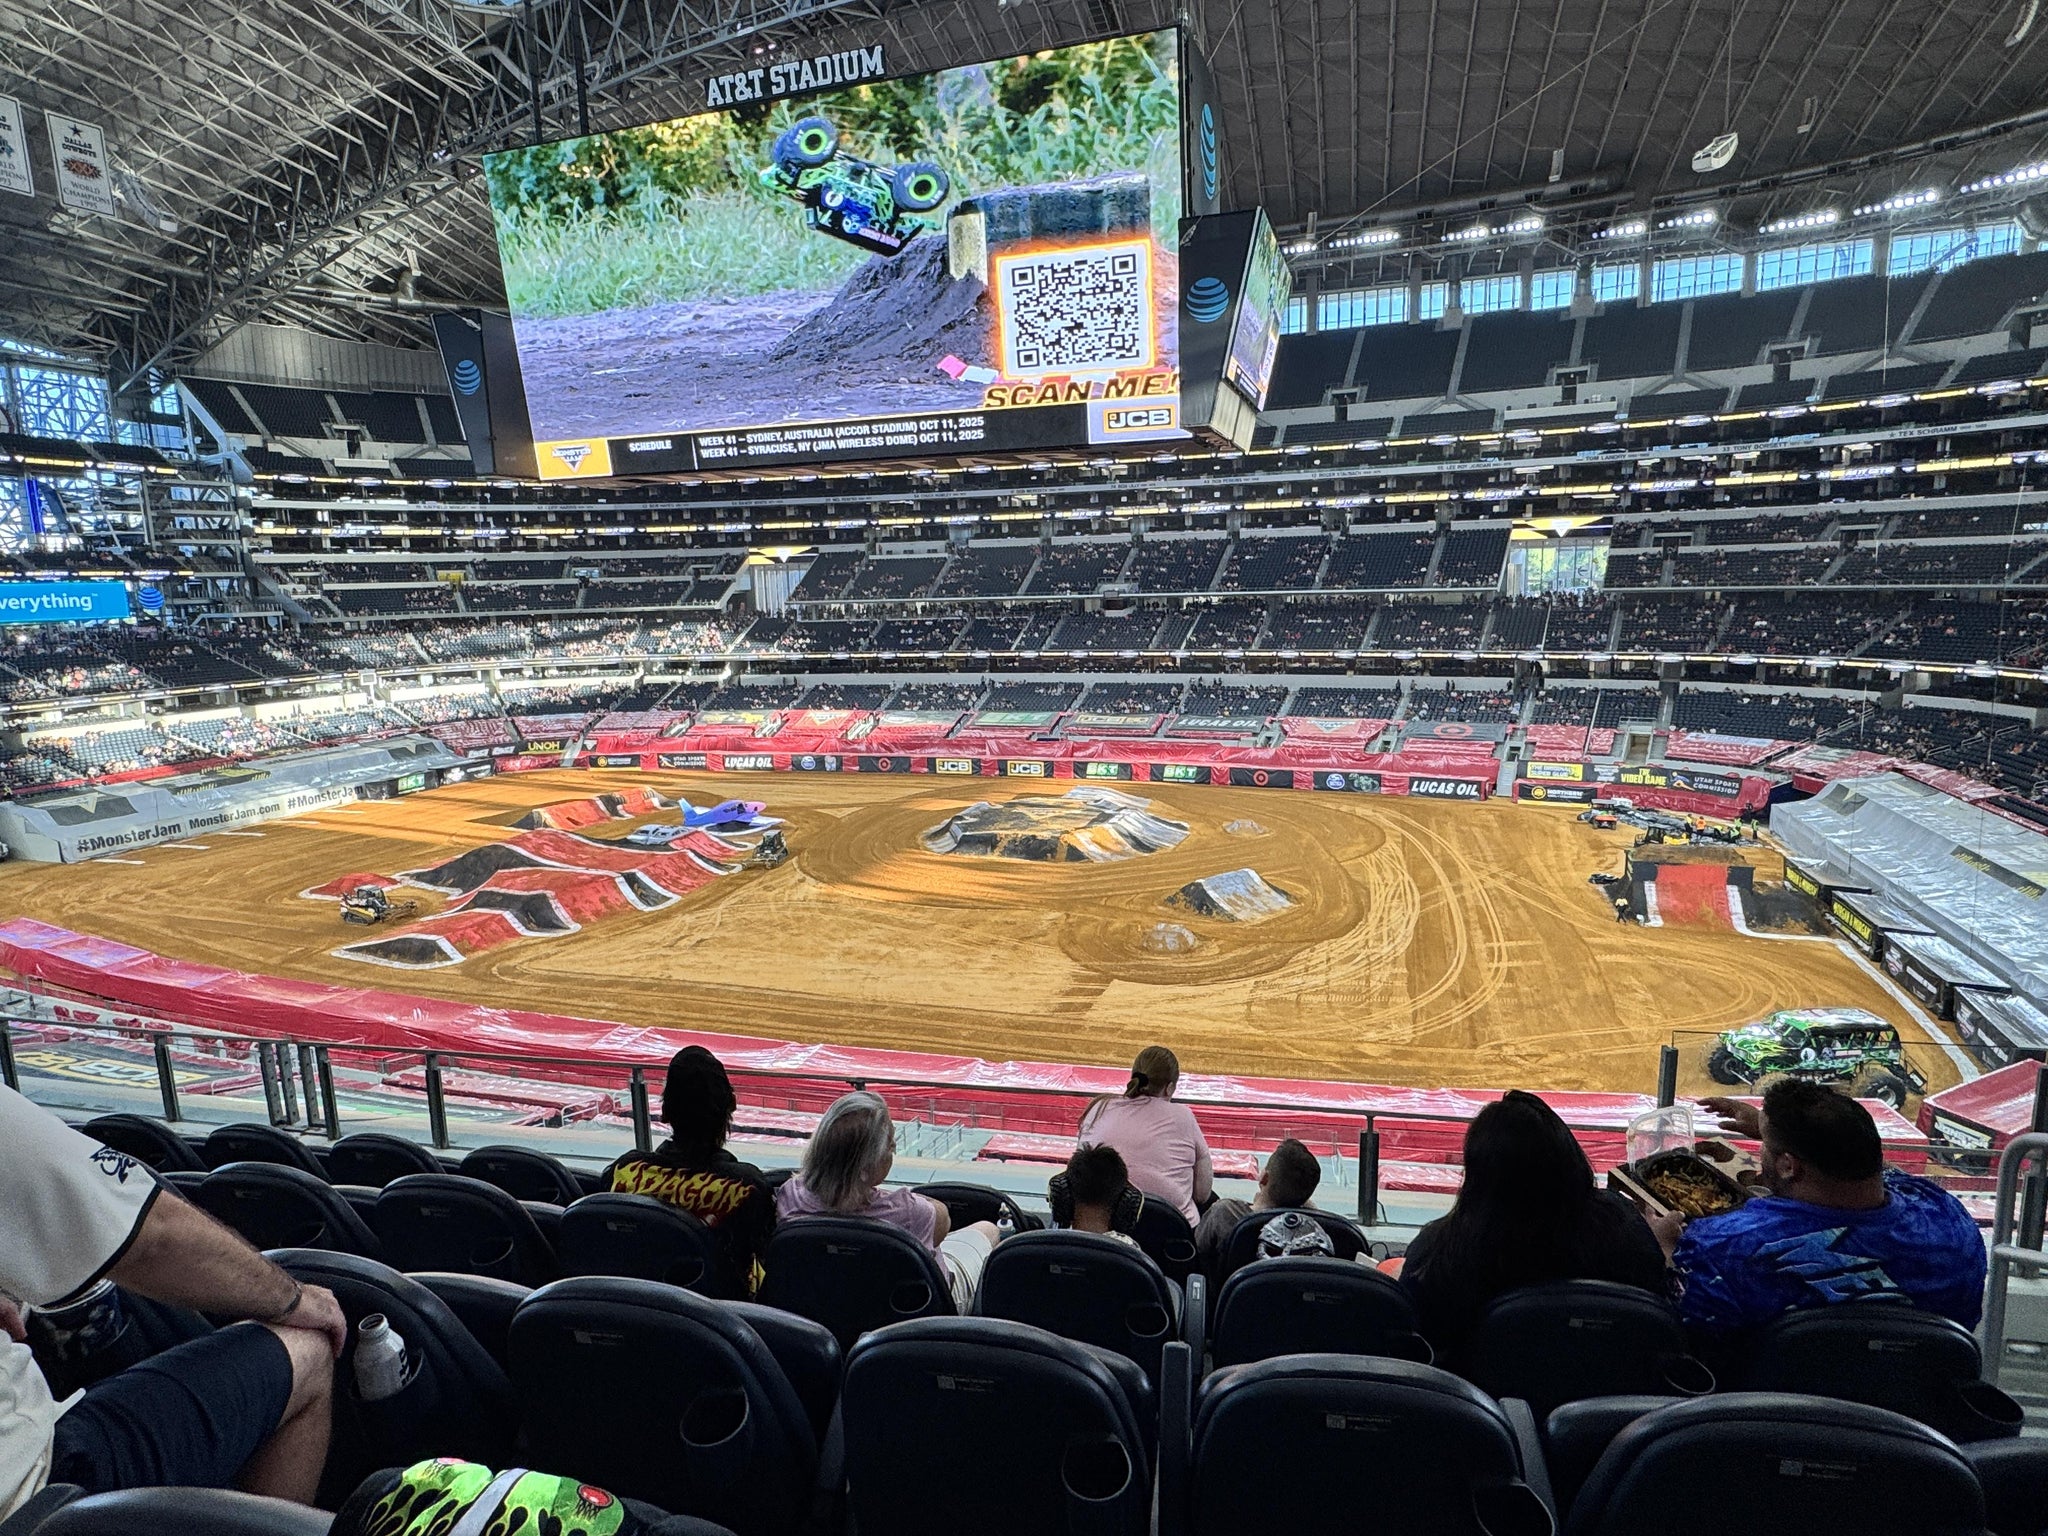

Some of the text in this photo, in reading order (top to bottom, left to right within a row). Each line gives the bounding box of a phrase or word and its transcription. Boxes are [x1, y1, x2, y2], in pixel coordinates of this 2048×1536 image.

[707, 45, 885, 107] AT&T STADIUM
[71, 181, 100, 195] WORLD
[63, 187, 111, 204] CHAMPIONS
[983, 371, 1179, 408] SCAN ME!
[1109, 409, 1171, 428] JCB
[699, 436, 726, 447] WEEK
[726, 435, 738, 446] 41
[747, 432, 784, 444] SYDNEY,
[784, 427, 833, 439] AUSTRALIA
[835, 425, 870, 439] (ACCOR
[872, 421, 918, 435] STADIUM)
[919, 419, 939, 430] OCT
[942, 418, 958, 430] 11,
[959, 416, 985, 428] 2025
[1917, 426, 1958, 435] SCHRAMM
[629, 440, 673, 452] SCHEDULE
[701, 447, 727, 458] WEEK
[727, 446, 739, 457] 41
[748, 442, 797, 456] SYRACUSE,
[799, 441, 811, 452] NY
[813, 439, 837, 453] (JMA
[838, 436, 884, 449] WIRELESS
[886, 433, 918, 446] DOME)
[920, 432, 939, 443] OCT
[942, 431, 958, 443] 11,
[959, 429, 985, 441] 2025
[1178, 719, 1259, 727] LUCAS OIL
[528, 741, 560, 751] UNOH
[725, 756, 773, 768] LUCAS OIL
[939, 761, 970, 771] JCB
[1010, 763, 1042, 774] JCB
[1164, 765, 1198, 778] BKT
[1621, 773, 1644, 783] VIDEO
[1645, 775, 1668, 786] GAME
[1694, 776, 1740, 789] UTAH SPORTS
[1411, 780, 1480, 796] LUCAS OIL
[1693, 782, 1738, 794] COMMISSION
[287, 784, 364, 810] #MonsterJam
[188, 802, 281, 830] MonsterJam.com
[76, 822, 182, 853] #MonsterJam
